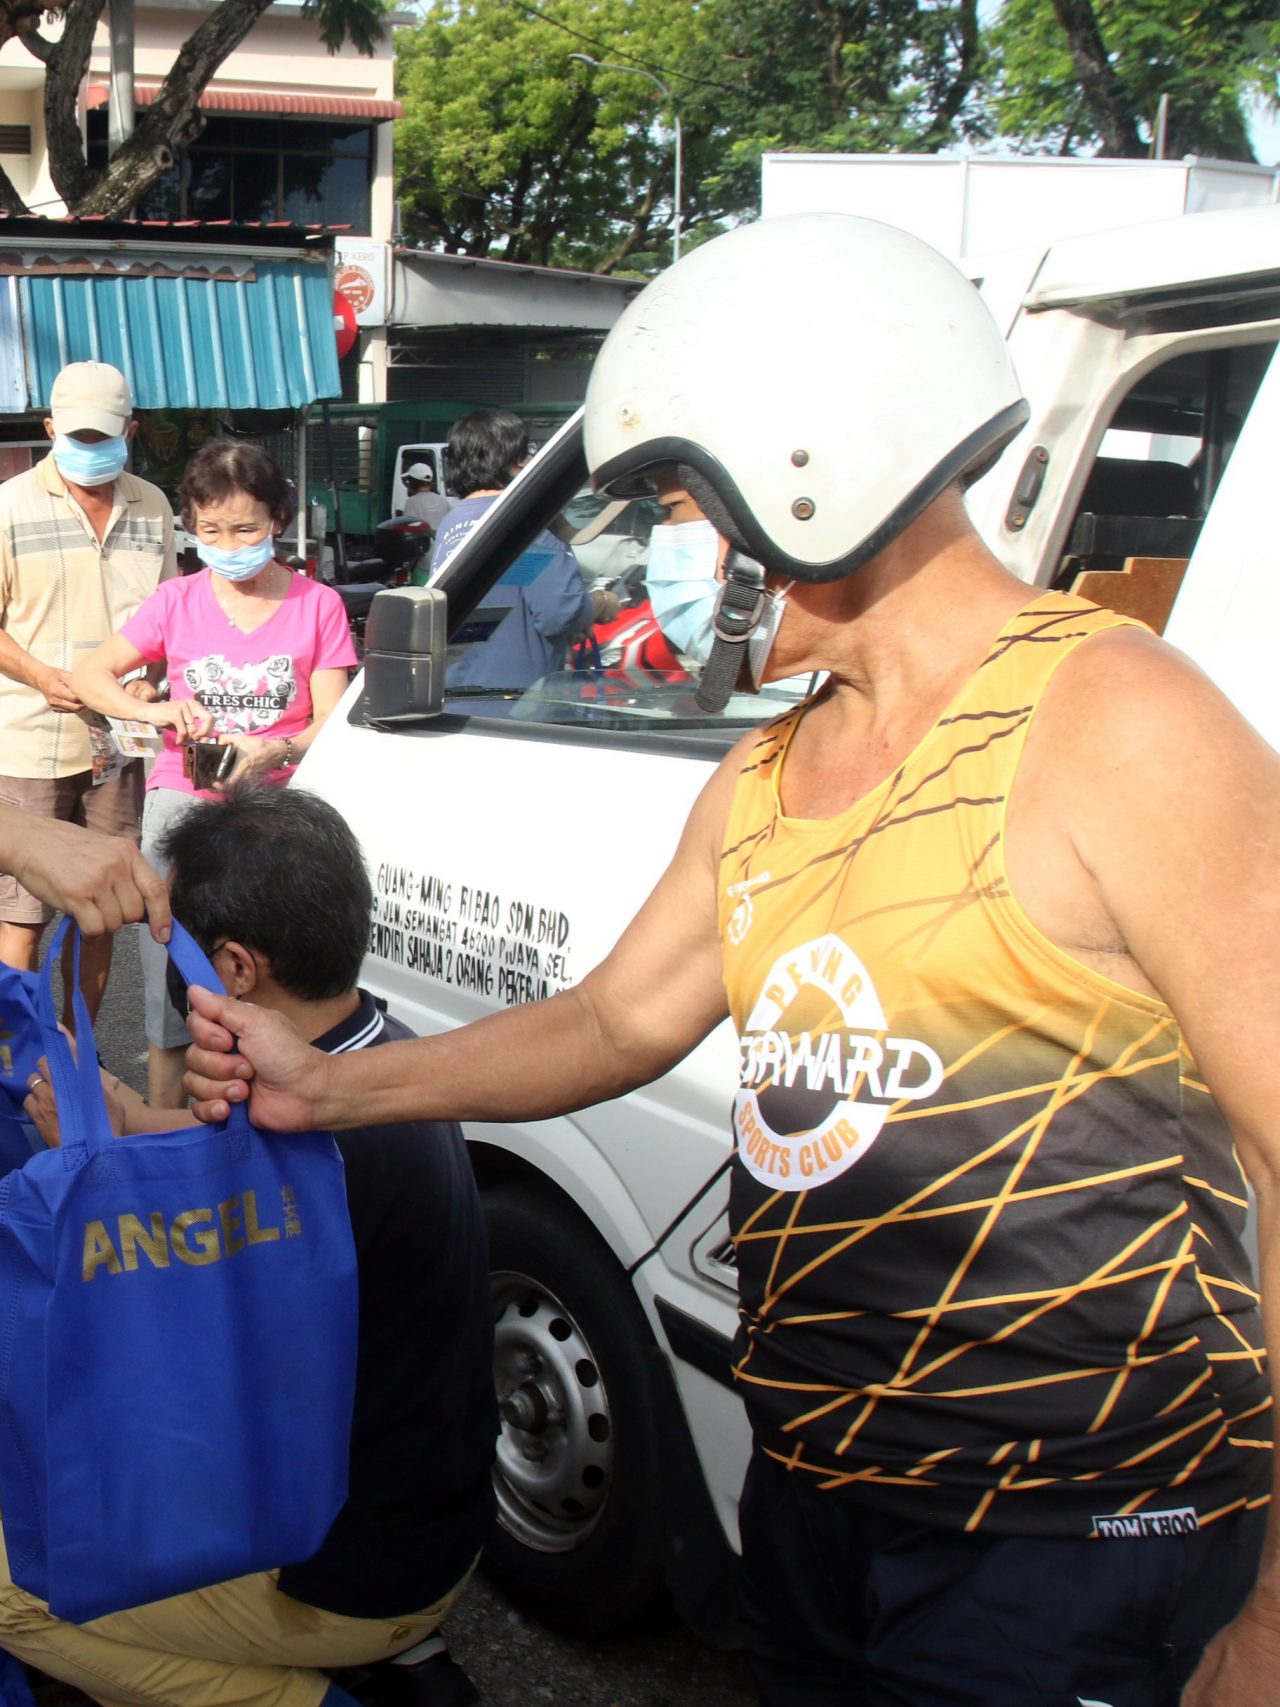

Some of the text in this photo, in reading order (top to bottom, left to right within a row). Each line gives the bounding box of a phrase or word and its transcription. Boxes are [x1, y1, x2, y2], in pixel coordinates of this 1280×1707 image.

[201, 695, 280, 708] TRES CHIC
[460, 885, 499, 929] RIBAO
[404, 909, 457, 945] SEMANGAT
[461, 926, 495, 958] 46200
[370, 922, 404, 965] ENDIRI
[407, 935, 443, 979] SAHAJA
[445, 949, 454, 984] 2
[456, 952, 493, 996] ORANG
[739, 1101, 860, 1178] SPORTS CLUB
[81, 1190, 280, 1283] ANGEL
[1098, 1512, 1199, 1537] TOM KHOO
